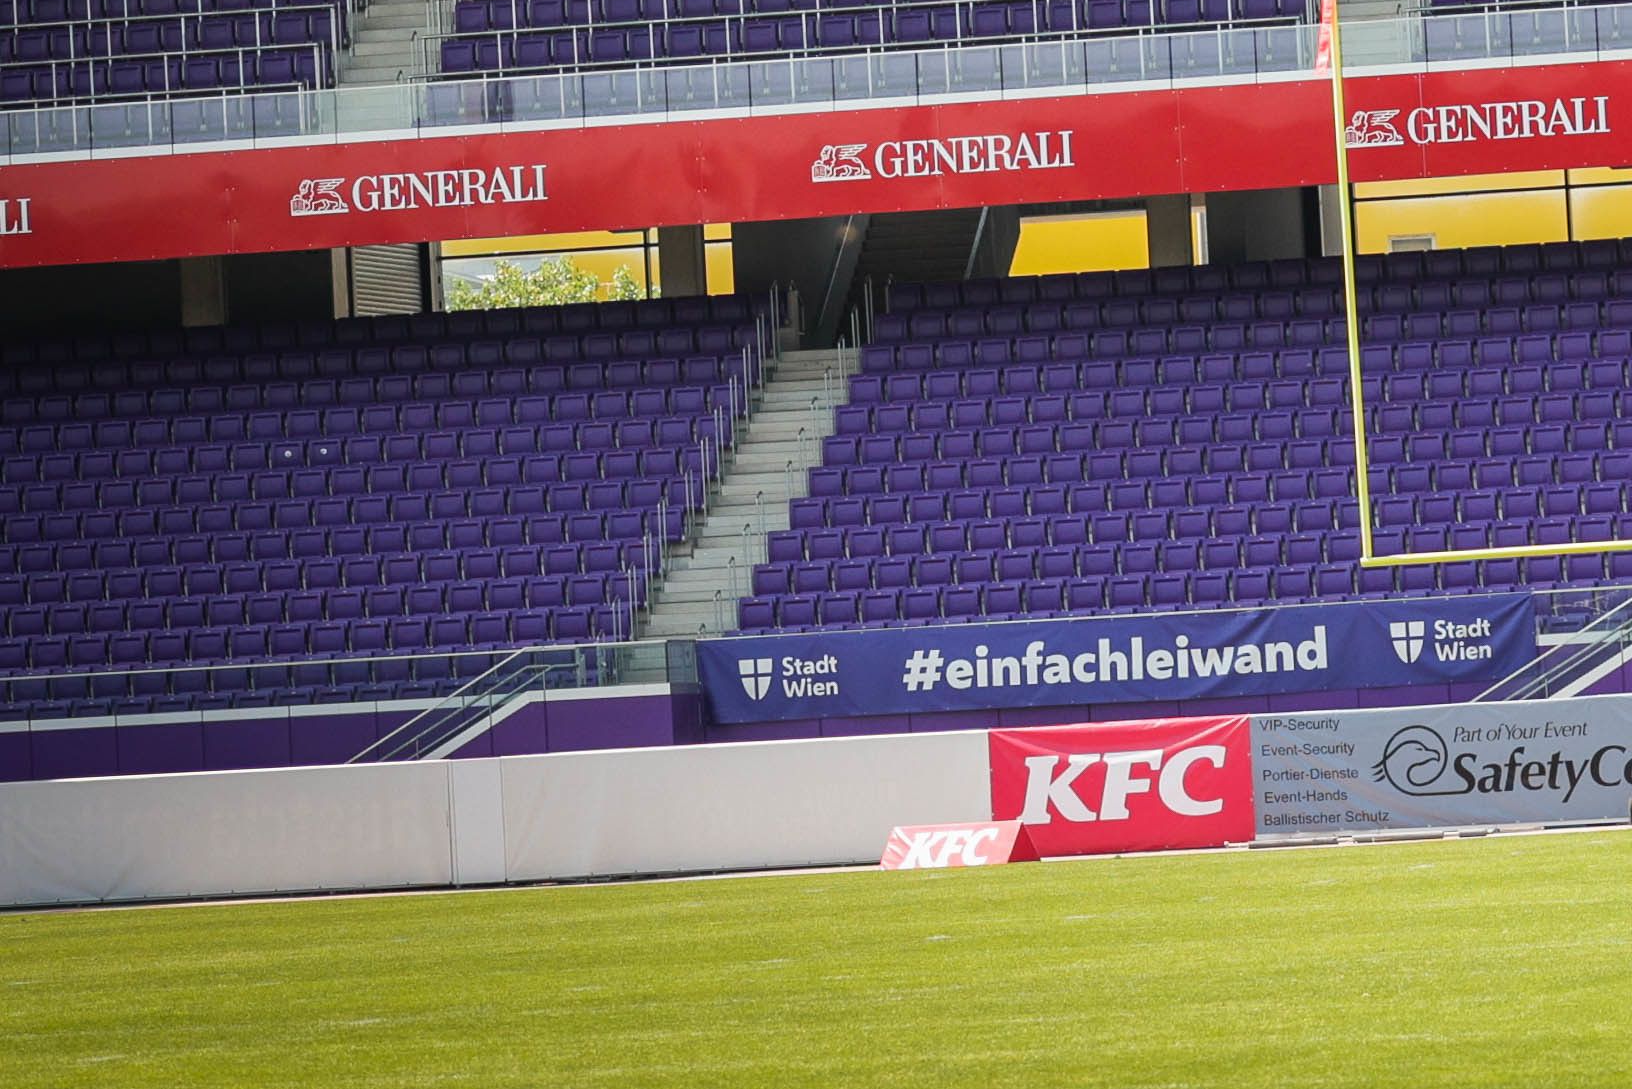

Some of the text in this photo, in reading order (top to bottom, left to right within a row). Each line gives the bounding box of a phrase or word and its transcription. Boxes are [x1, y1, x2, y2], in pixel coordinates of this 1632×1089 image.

[1406, 96, 1611, 145] GENERALI
[874, 130, 1075, 178] GENERALI
[352, 164, 548, 211] GENERALI
[1433, 618, 1491, 640] Stadt
[902, 625, 1328, 692] #einfachleiwand
[1435, 642, 1492, 662] Wien
[782, 654, 838, 676] Stadt
[783, 677, 839, 698] Wien
[1259, 718, 1340, 732] VIP-Security
[1454, 721, 1588, 742] Part of Your Event
[1262, 742, 1355, 757] Event-Security
[1016, 745, 1226, 825] KFC
[1263, 768, 1359, 781] Portier-Dienste
[1264, 789, 1348, 803] Event-Hands
[1264, 810, 1390, 826] Ballistischer Schutz
[898, 827, 1000, 869] KFC
